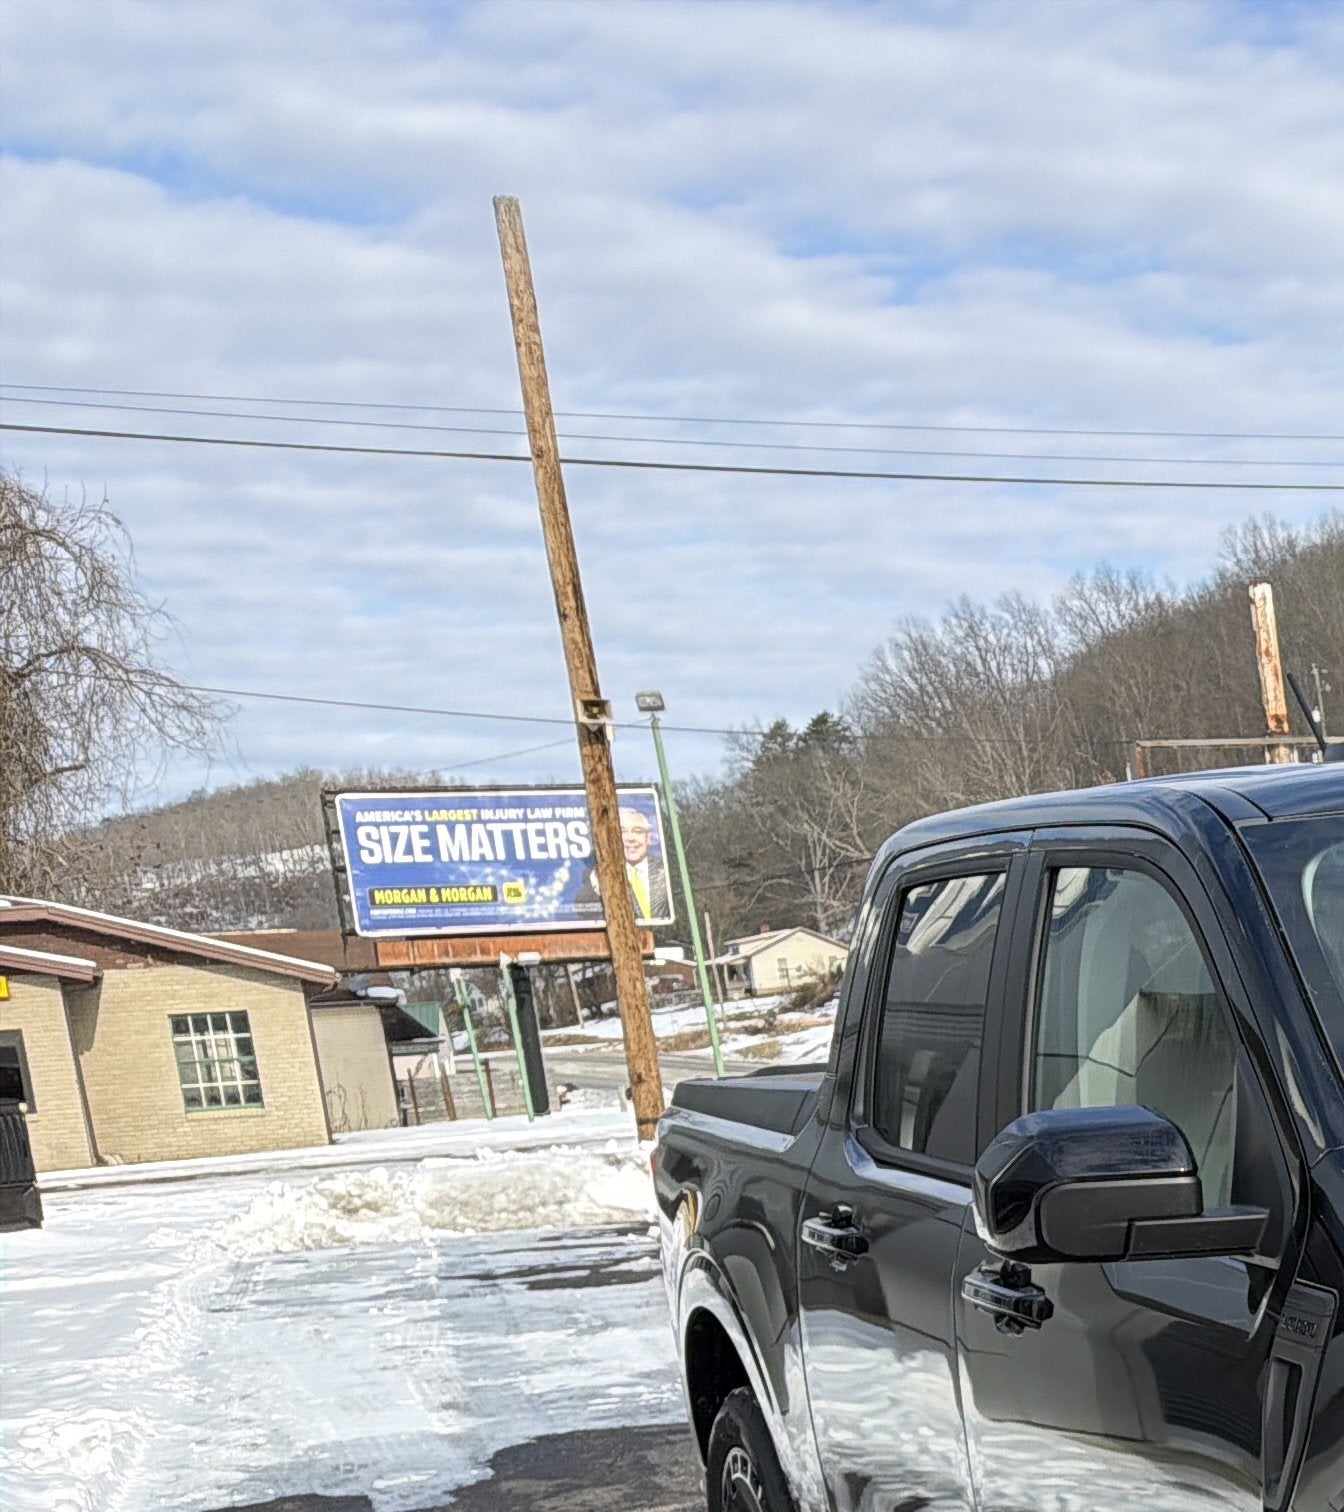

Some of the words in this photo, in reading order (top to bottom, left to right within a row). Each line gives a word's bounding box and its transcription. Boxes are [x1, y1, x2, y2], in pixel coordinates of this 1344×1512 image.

[355, 810, 423, 823] AMERICA'S
[424, 809, 479, 821] LARGEST
[480, 808, 525, 820] INJURY
[526, 807, 553, 819] LAW
[555, 806, 586, 819] FIRM
[356, 825, 434, 864] SIZE
[435, 820, 591, 863] MATTERS
[373, 888, 427, 905] MORGAN
[429, 887, 440, 903] &
[441, 886, 493, 903] MORGAN
